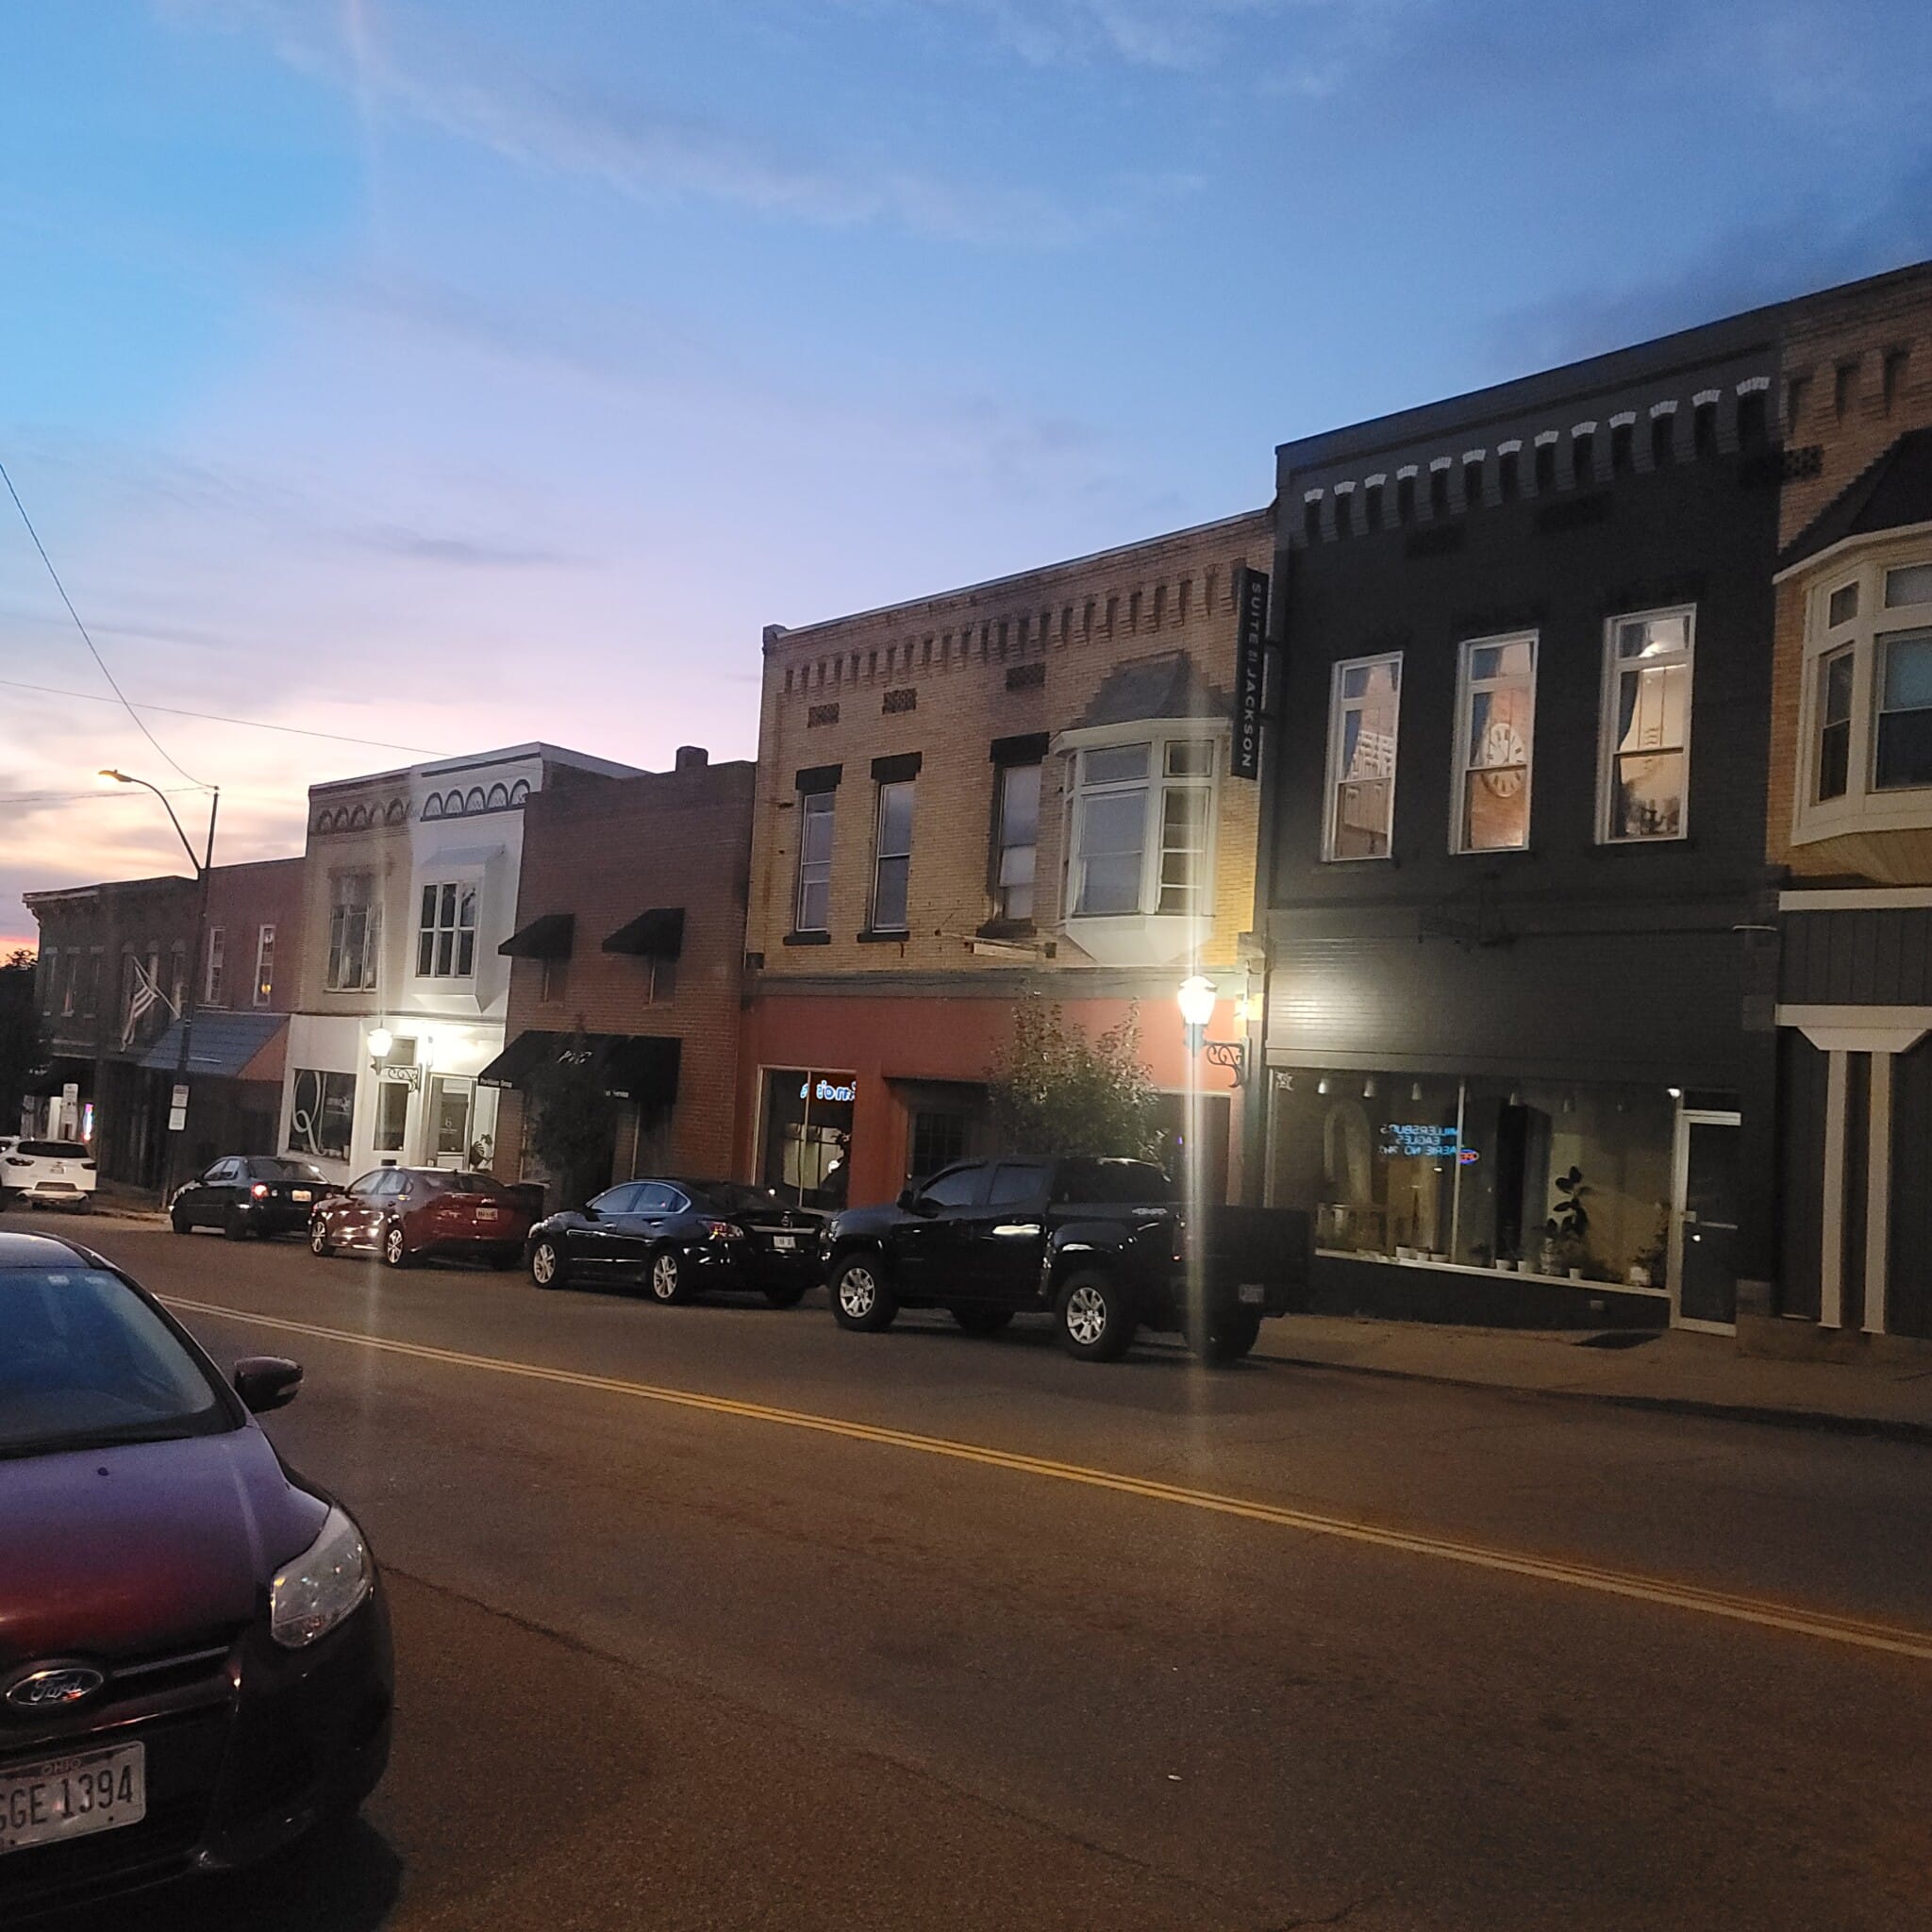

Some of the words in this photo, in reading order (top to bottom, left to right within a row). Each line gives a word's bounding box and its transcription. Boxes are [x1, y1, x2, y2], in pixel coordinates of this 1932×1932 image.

[1248, 582, 1261, 645] SUITE
[1241, 667, 1257, 768] JACKSON
[30, 1674, 83, 1702] Ford
[42, 1757, 82, 1776] OHIO
[60, 1764, 134, 1820] 1394
